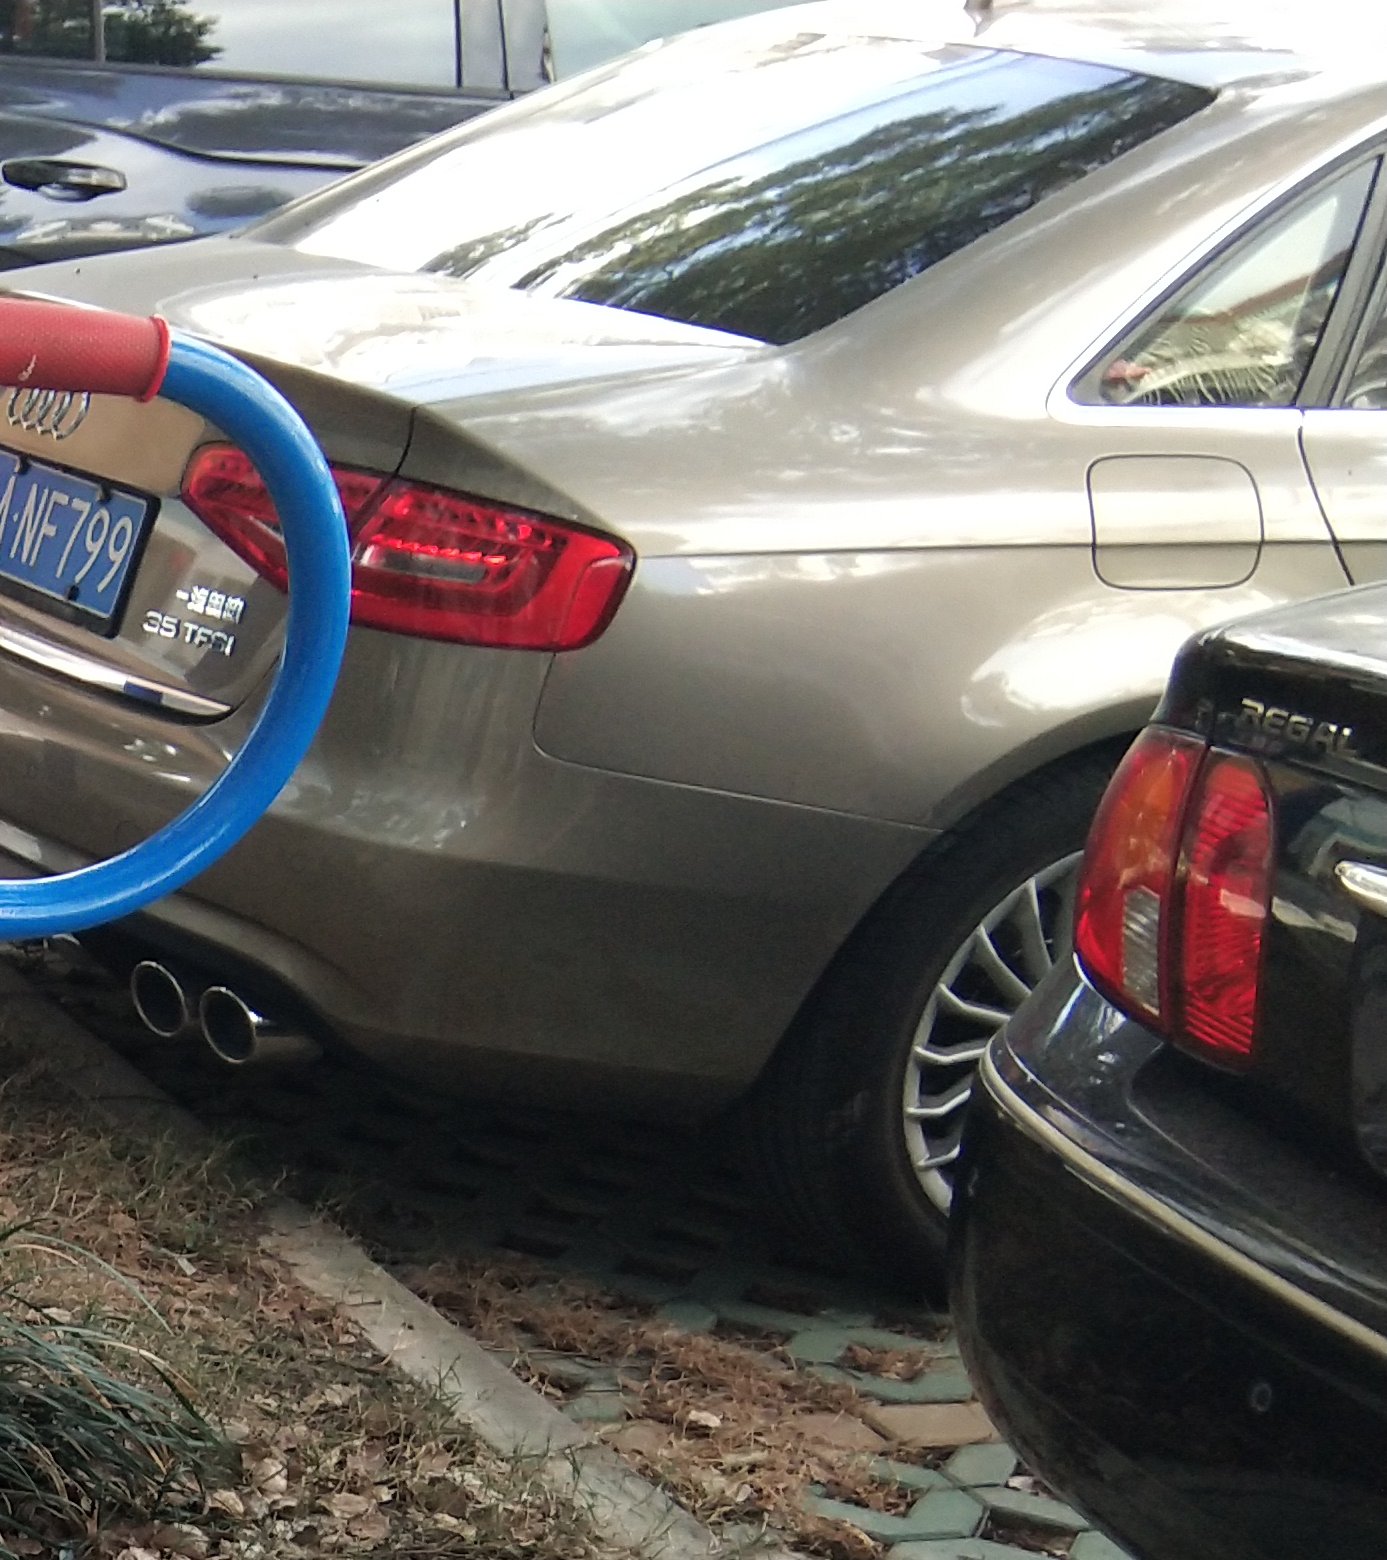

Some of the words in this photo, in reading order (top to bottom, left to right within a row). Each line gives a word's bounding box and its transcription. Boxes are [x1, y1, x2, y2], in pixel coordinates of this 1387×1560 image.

[142, 609, 181, 638] 35
[183, 620, 236, 657] TFSI
[1238, 697, 1358, 755] REGAL
